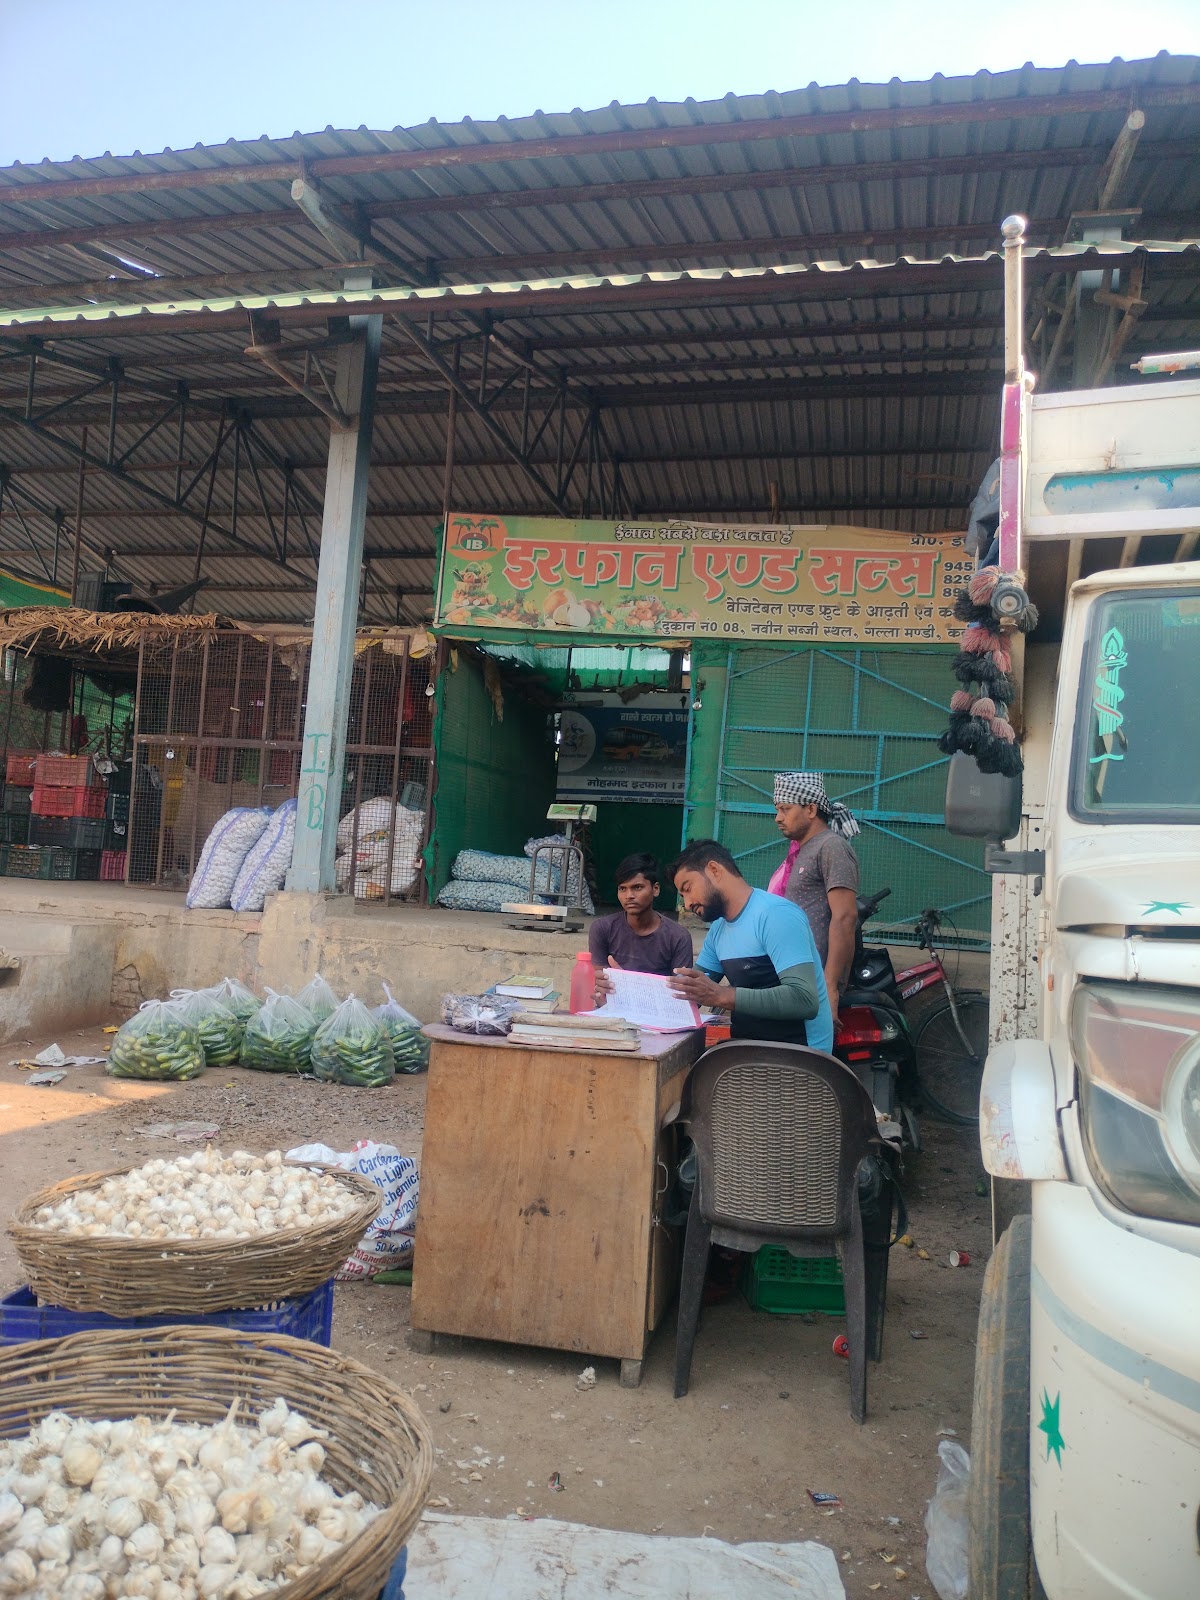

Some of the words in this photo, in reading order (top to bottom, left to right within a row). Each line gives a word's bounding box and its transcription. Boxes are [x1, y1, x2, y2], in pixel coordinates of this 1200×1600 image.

[615, 523, 656, 541] ईमान
[659, 526, 698, 540] सबसे
[465, 538, 483, 550] IB
[503, 538, 686, 592] इरफान
[691, 546, 803, 603] एण्ड
[808, 548, 940, 598] सन्स
[726, 596, 783, 615] वेजिटेबल
[788, 603, 816, 618] एण्ड
[846, 600, 861, 617] के
[866, 601, 909, 622] आढ़ती
[914, 602, 933, 620] एवं
[661, 620, 696, 636] दुकान
[751, 619, 783, 635] नवीन
[787, 620, 819, 636] सब्जी
[824, 625, 859, 640] स्थल,
[865, 626, 899, 639] गल्ला
[904, 623, 942, 640] मण्डी,
[587, 777, 628, 788] मोहम्मद
[631, 781, 667, 789] इरफान
[375, 1241, 387, 1252] 50
